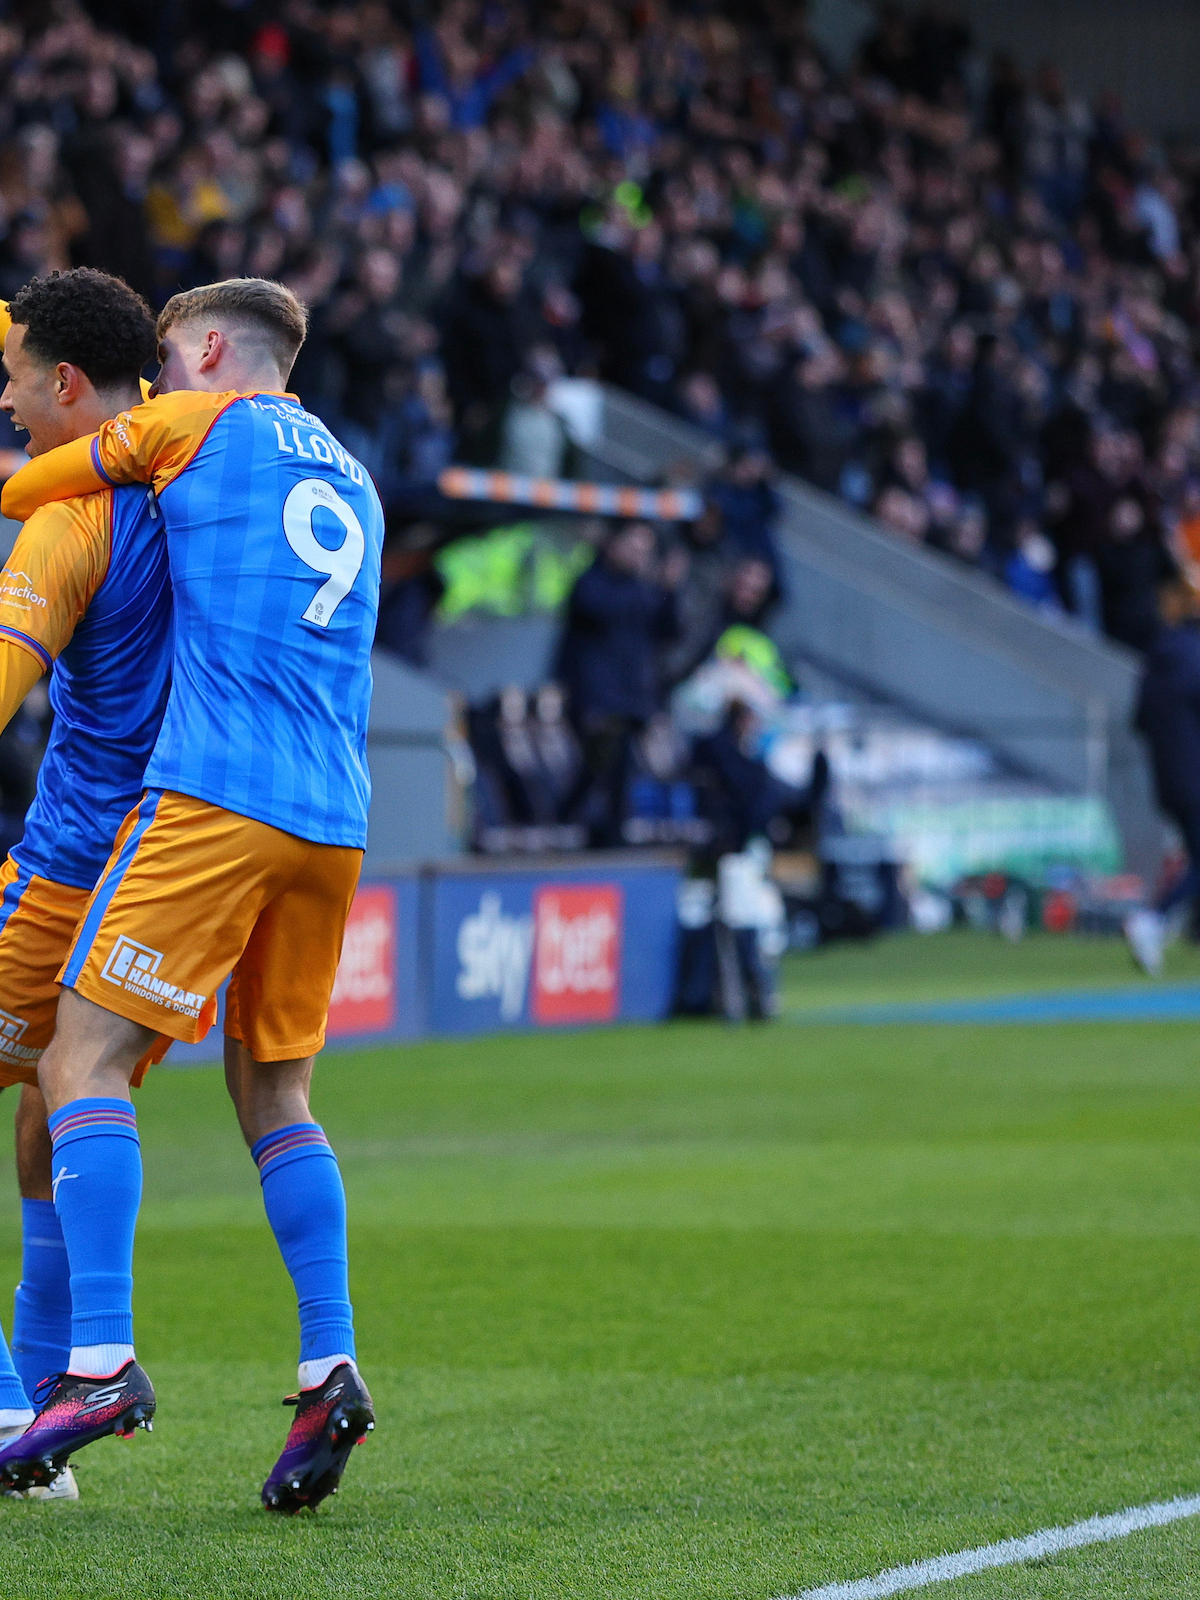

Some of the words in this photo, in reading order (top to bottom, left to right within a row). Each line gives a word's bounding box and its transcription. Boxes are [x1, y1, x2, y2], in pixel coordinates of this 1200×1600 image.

[273, 421, 363, 487] LLOYD
[282, 477, 366, 628] 9
[127, 967, 206, 1010] HANMART
[457, 890, 536, 1023] sky
[539, 898, 617, 993] bet
[124, 981, 165, 1006] WINDOWS
[165, 1000, 172, 1009] &
[173, 1002, 201, 1019] DOORS
